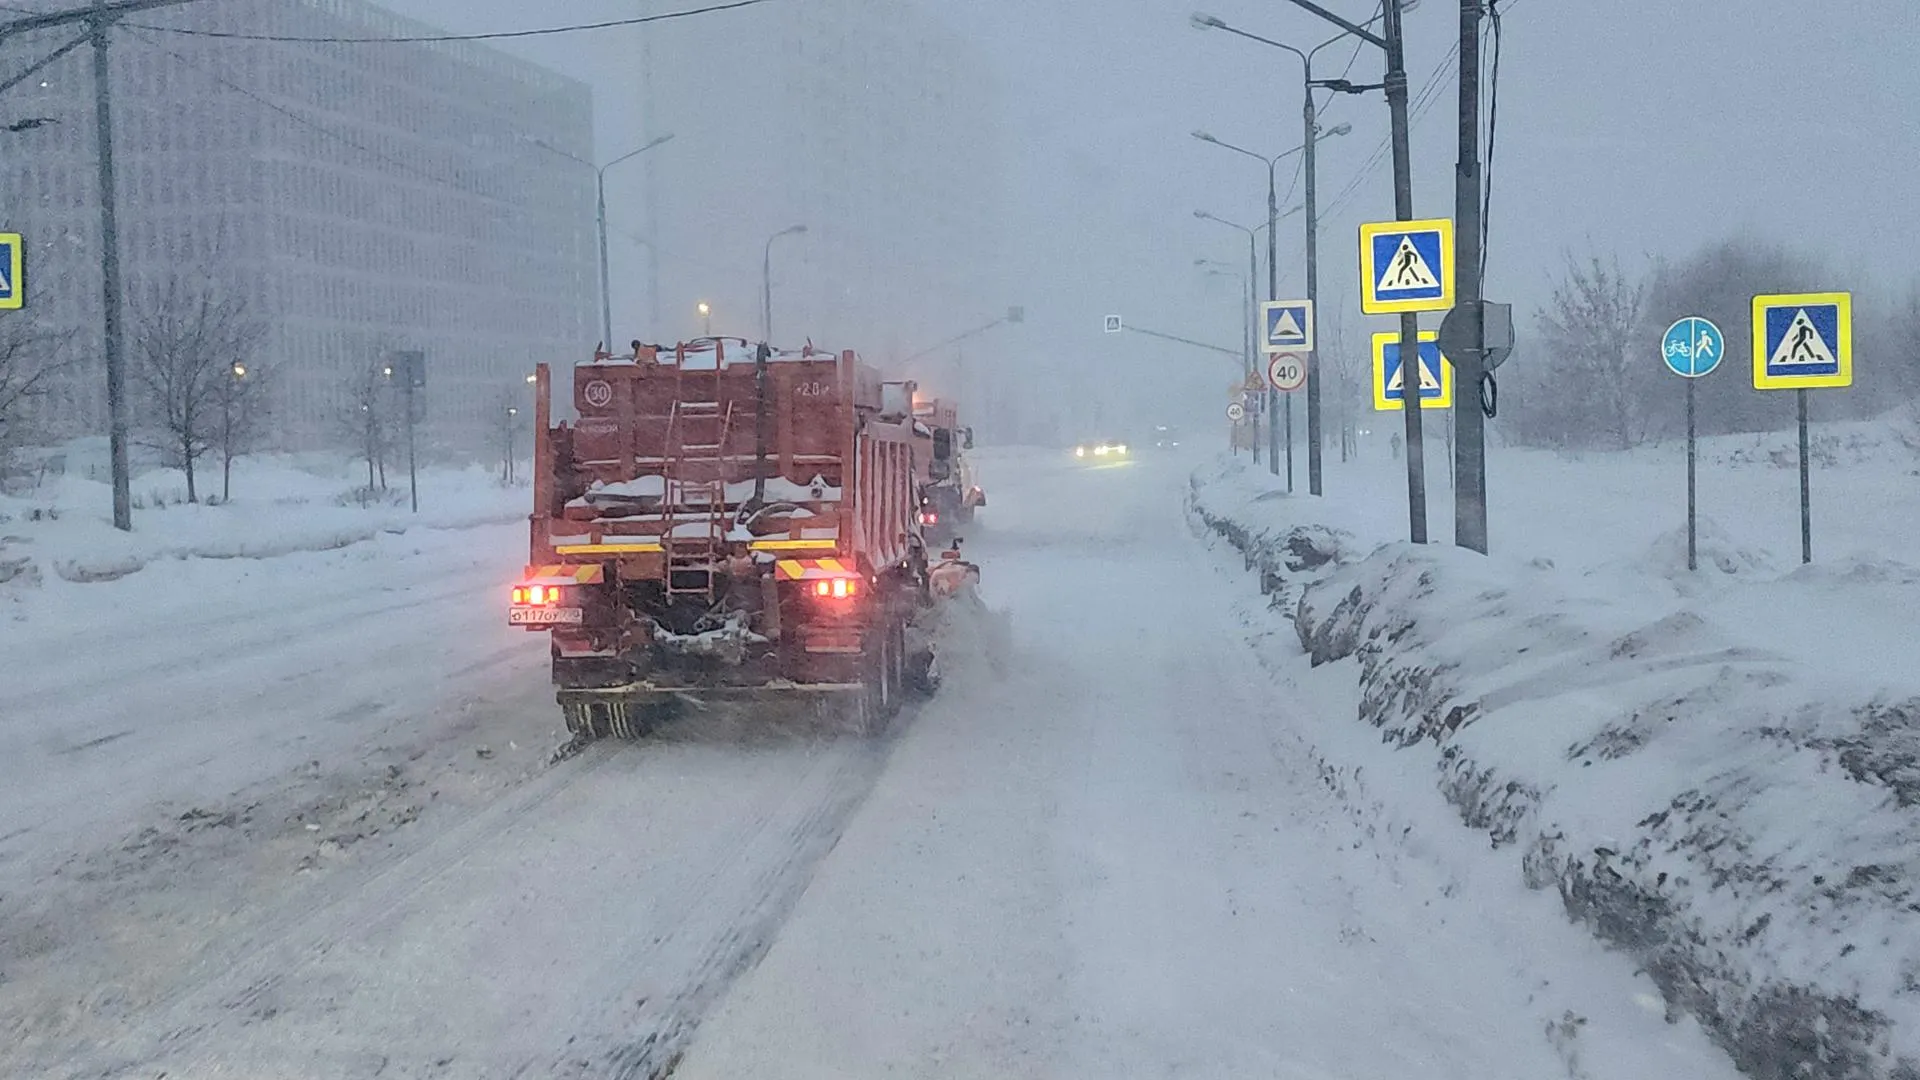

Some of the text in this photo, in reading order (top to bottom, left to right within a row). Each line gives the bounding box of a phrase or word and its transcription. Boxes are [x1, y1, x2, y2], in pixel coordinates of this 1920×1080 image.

[1276, 365, 1297, 380] 40
[590, 386, 608, 401] 30
[1230, 407, 1241, 416] 40
